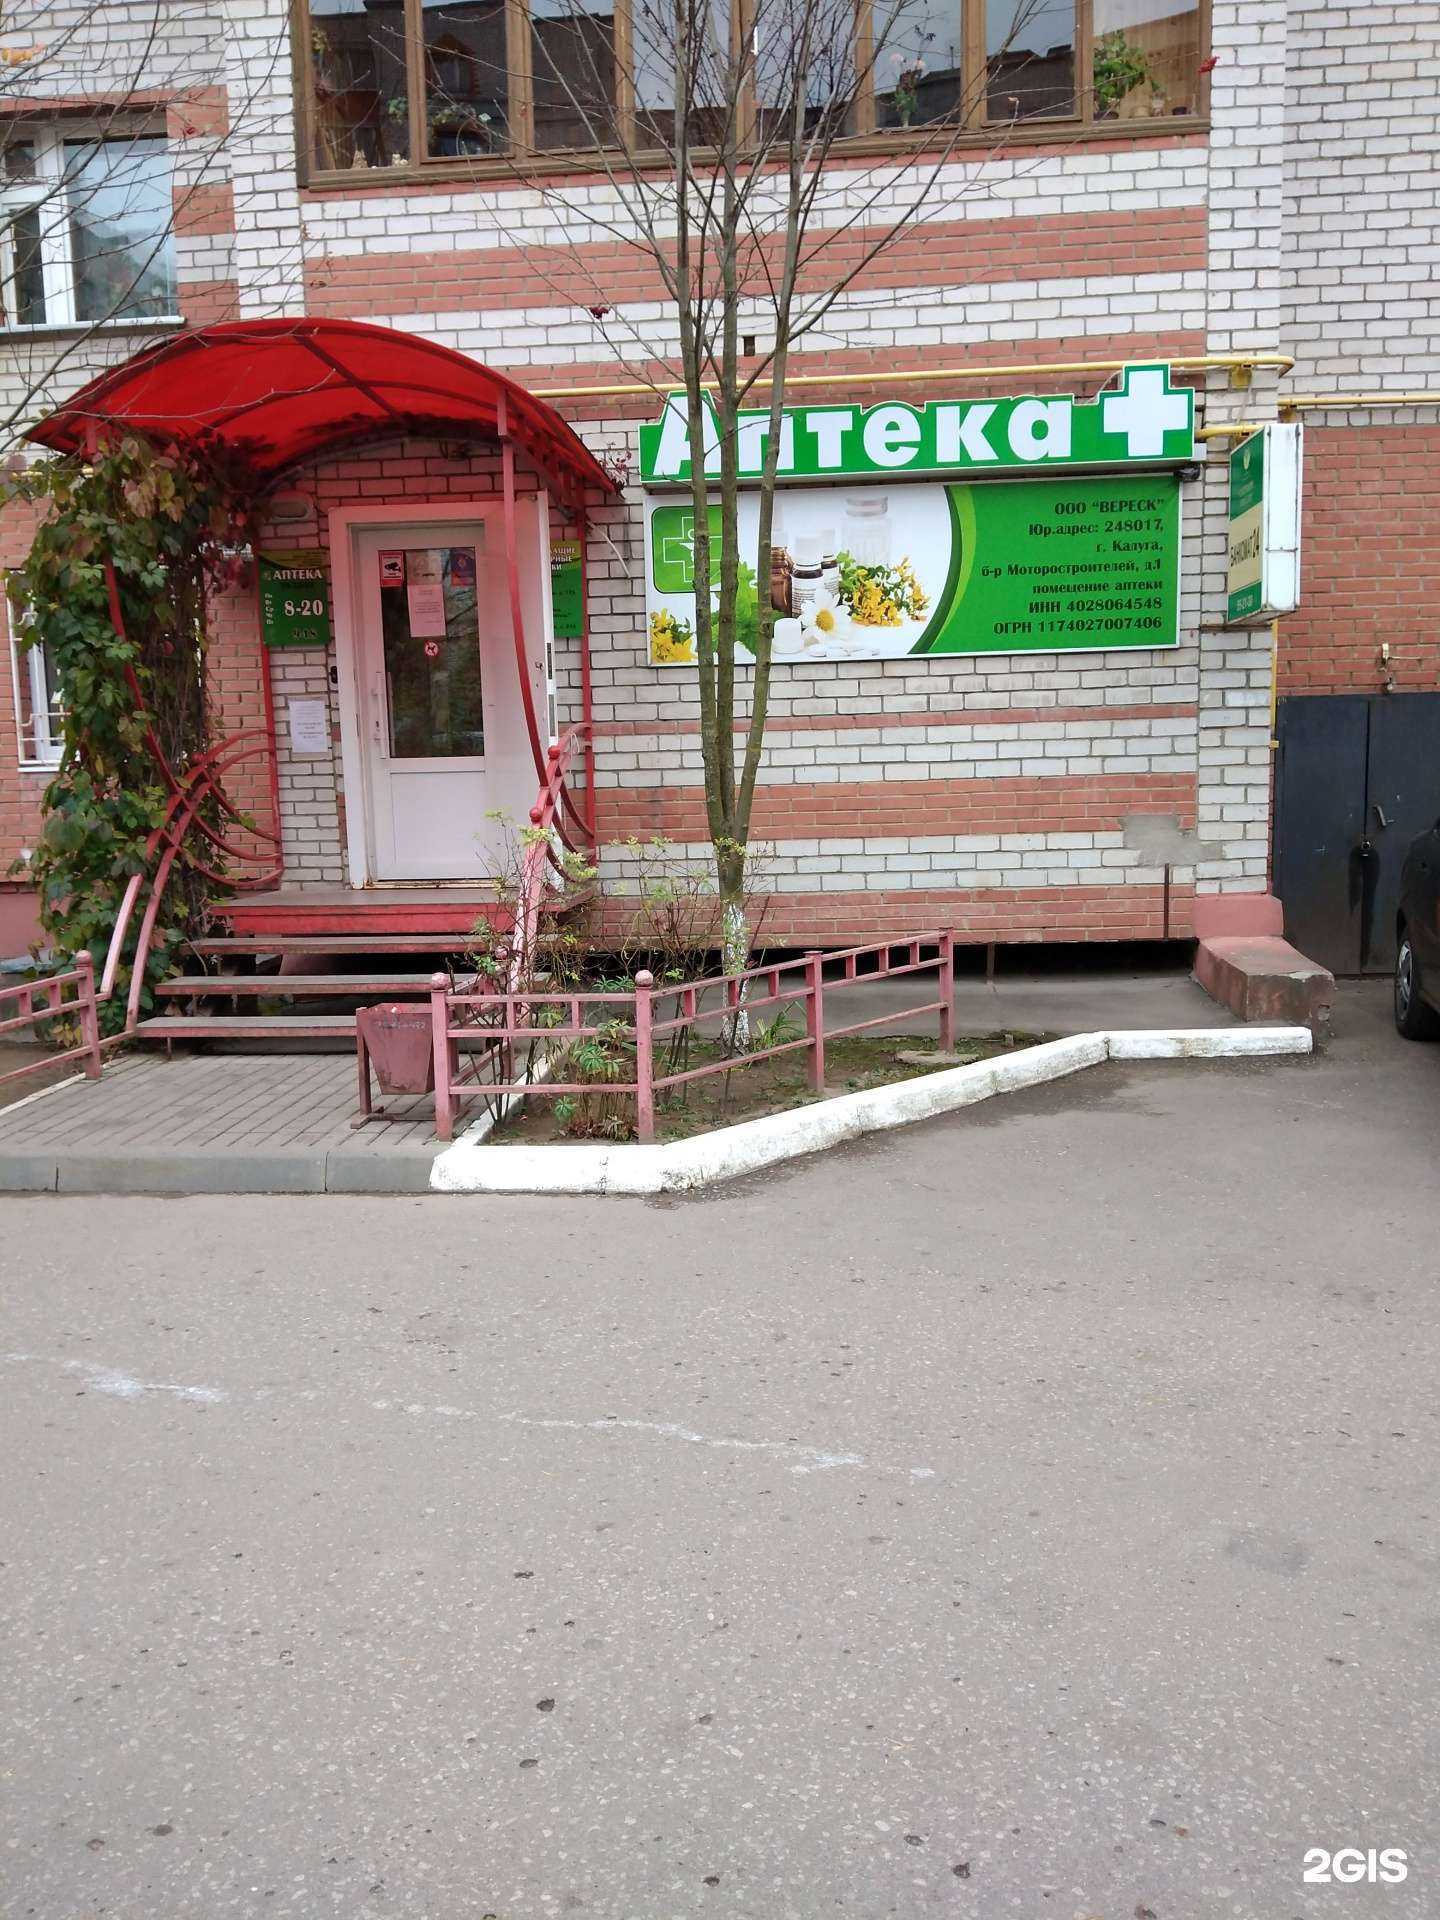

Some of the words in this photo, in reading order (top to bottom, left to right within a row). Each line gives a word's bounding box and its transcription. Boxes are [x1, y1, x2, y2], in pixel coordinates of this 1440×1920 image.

[653, 396, 1072, 474] Аптека
[1054, 502, 1086, 515] ООО
[1105, 518, 1164, 533] 248017,
[1112, 540, 1163, 553] Калуга,
[273, 569, 322, 580] АПТЕКА
[981, 566, 1002, 579] б-р
[1032, 582, 1109, 594] помещение
[1114, 580, 1163, 591] аптеки
[284, 599, 323, 617] 8-20
[1029, 601, 1061, 614] ИНН
[1067, 597, 1162, 612] 4028064548
[993, 622, 1032, 635] ОГРН
[1039, 617, 1162, 633] 1174027007406
